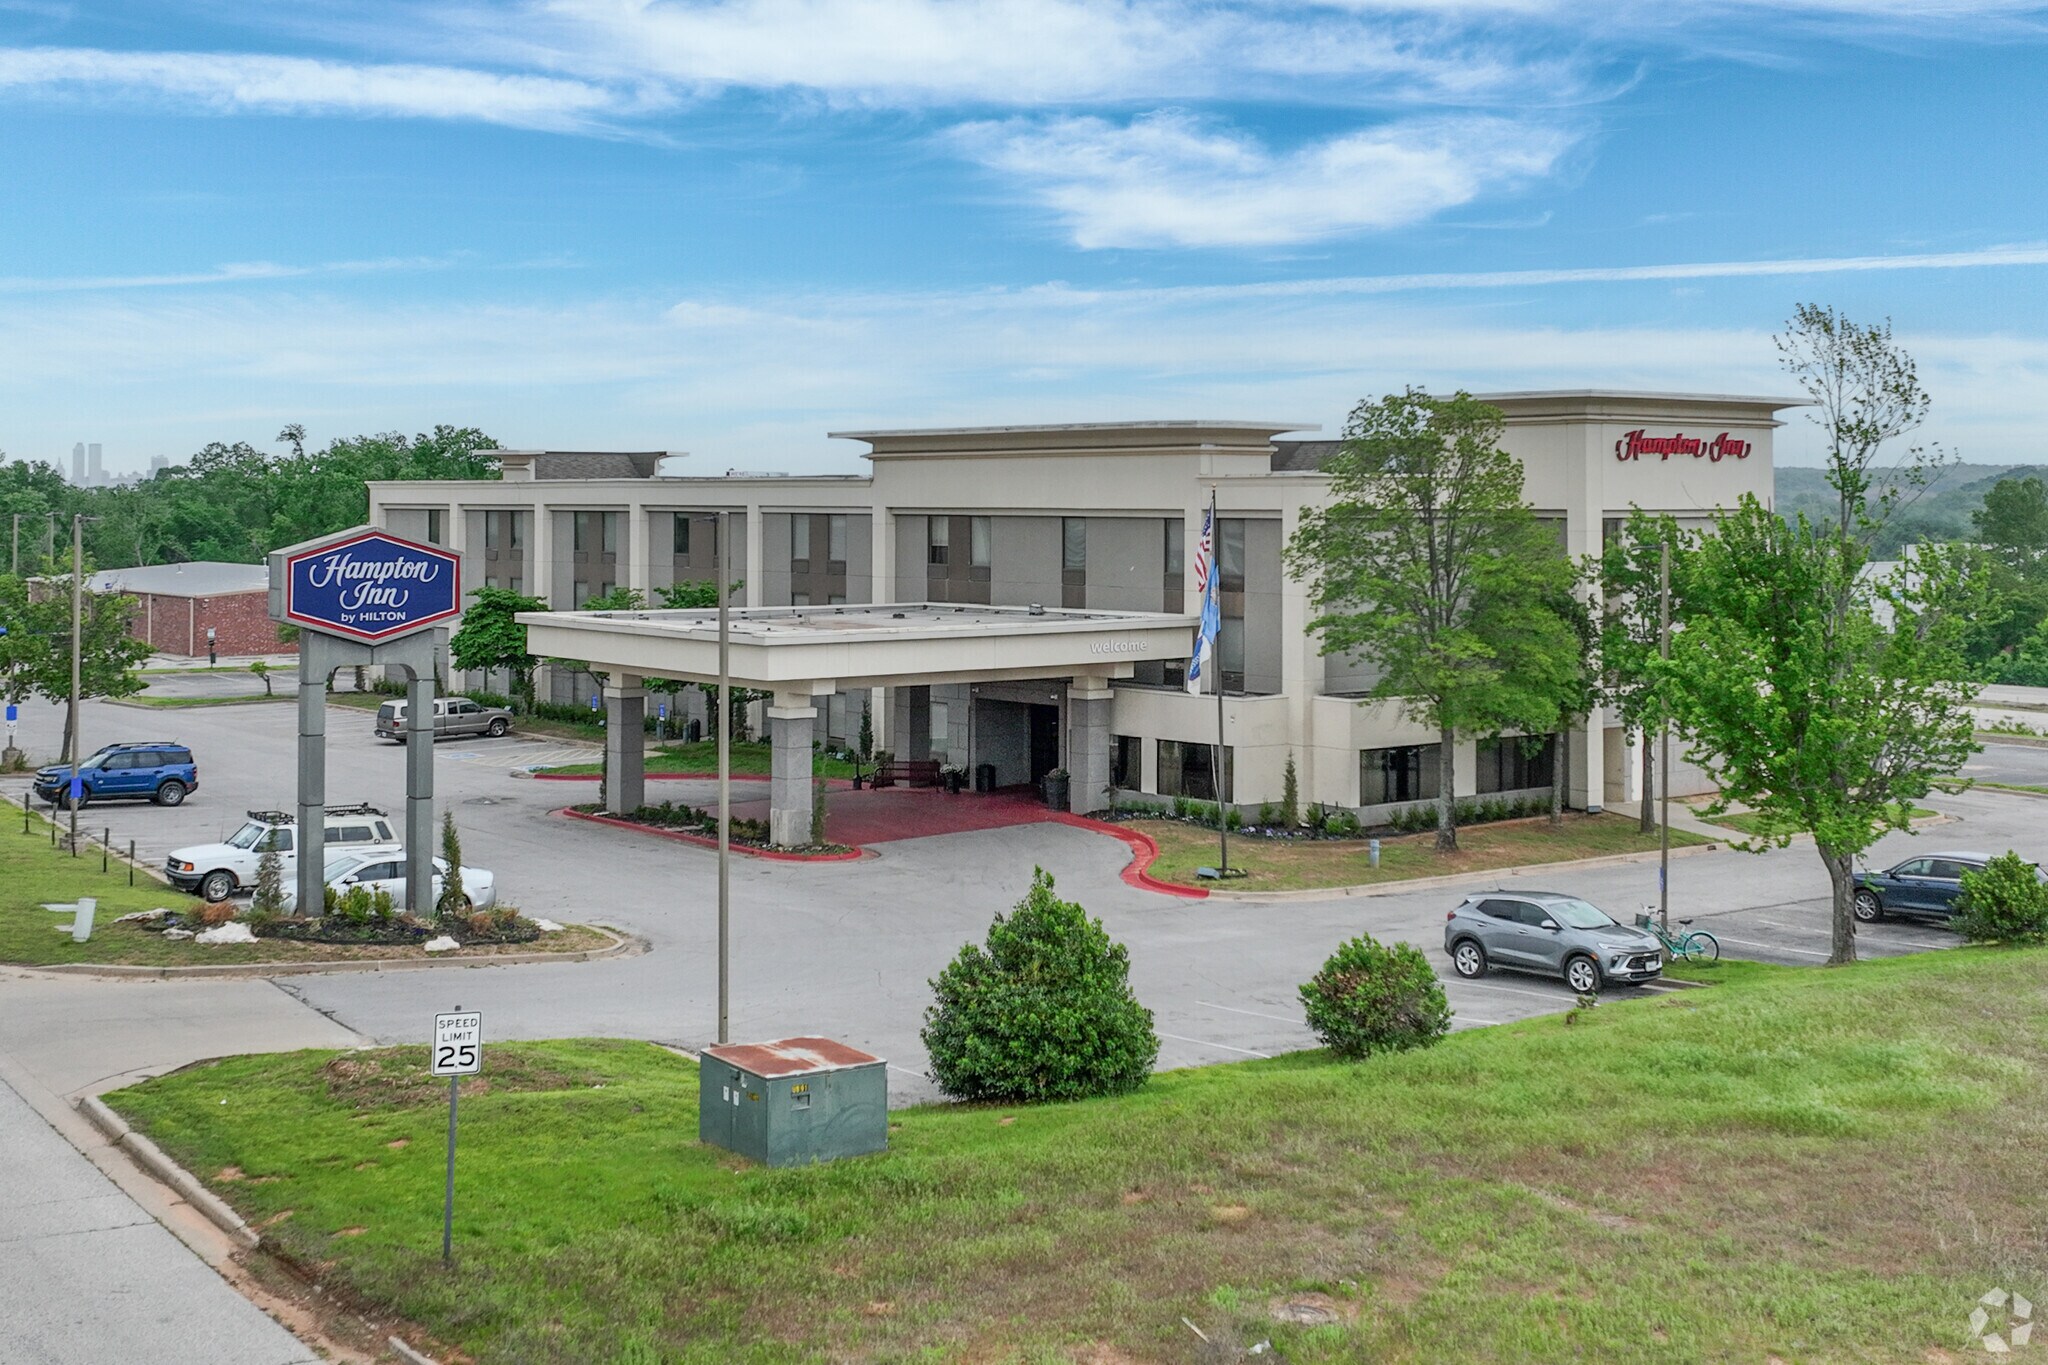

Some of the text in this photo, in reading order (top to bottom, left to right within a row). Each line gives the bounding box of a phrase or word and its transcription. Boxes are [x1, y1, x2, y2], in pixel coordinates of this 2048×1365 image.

[1615, 429, 1751, 462] Hampton Inn
[309, 552, 439, 588] Hampton
[339, 580, 409, 610] Inn
[341, 611, 406, 623] by HILTON
[1090, 639, 1147, 654] welcome
[439, 1018, 478, 1029] SPEED
[442, 1031, 472, 1042] LIMIT
[437, 1044, 476, 1068] 25
